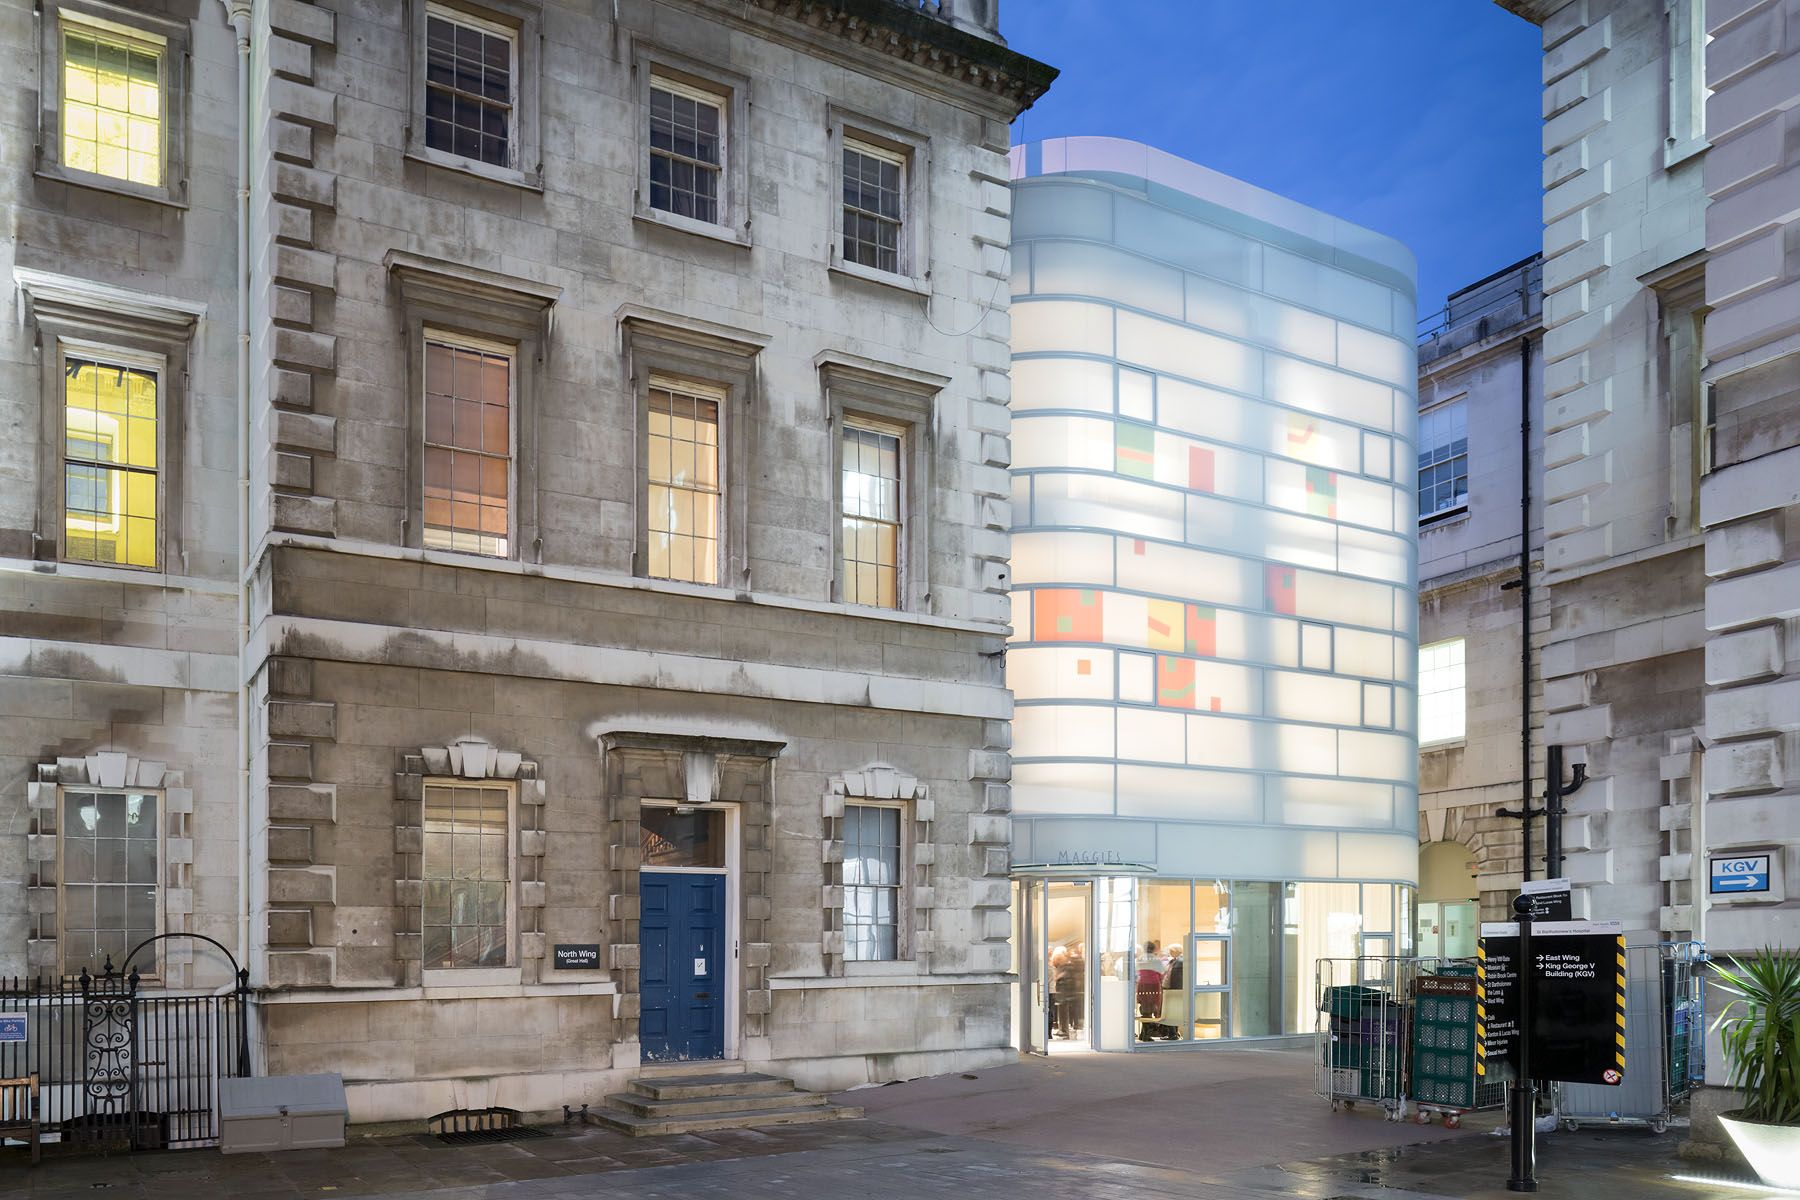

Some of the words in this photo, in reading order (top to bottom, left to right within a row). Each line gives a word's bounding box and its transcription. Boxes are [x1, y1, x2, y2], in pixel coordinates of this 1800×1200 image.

[1722, 860, 1758, 873] KGV
[557, 950, 578, 958] North
[578, 950, 597, 959] Wing
[1561, 954, 1580, 962] Wing
[1545, 962, 1561, 970] King
[1562, 962, 1589, 970] George
[1545, 970, 1574, 978] Building
[1574, 970, 1595, 978] (KGV)
